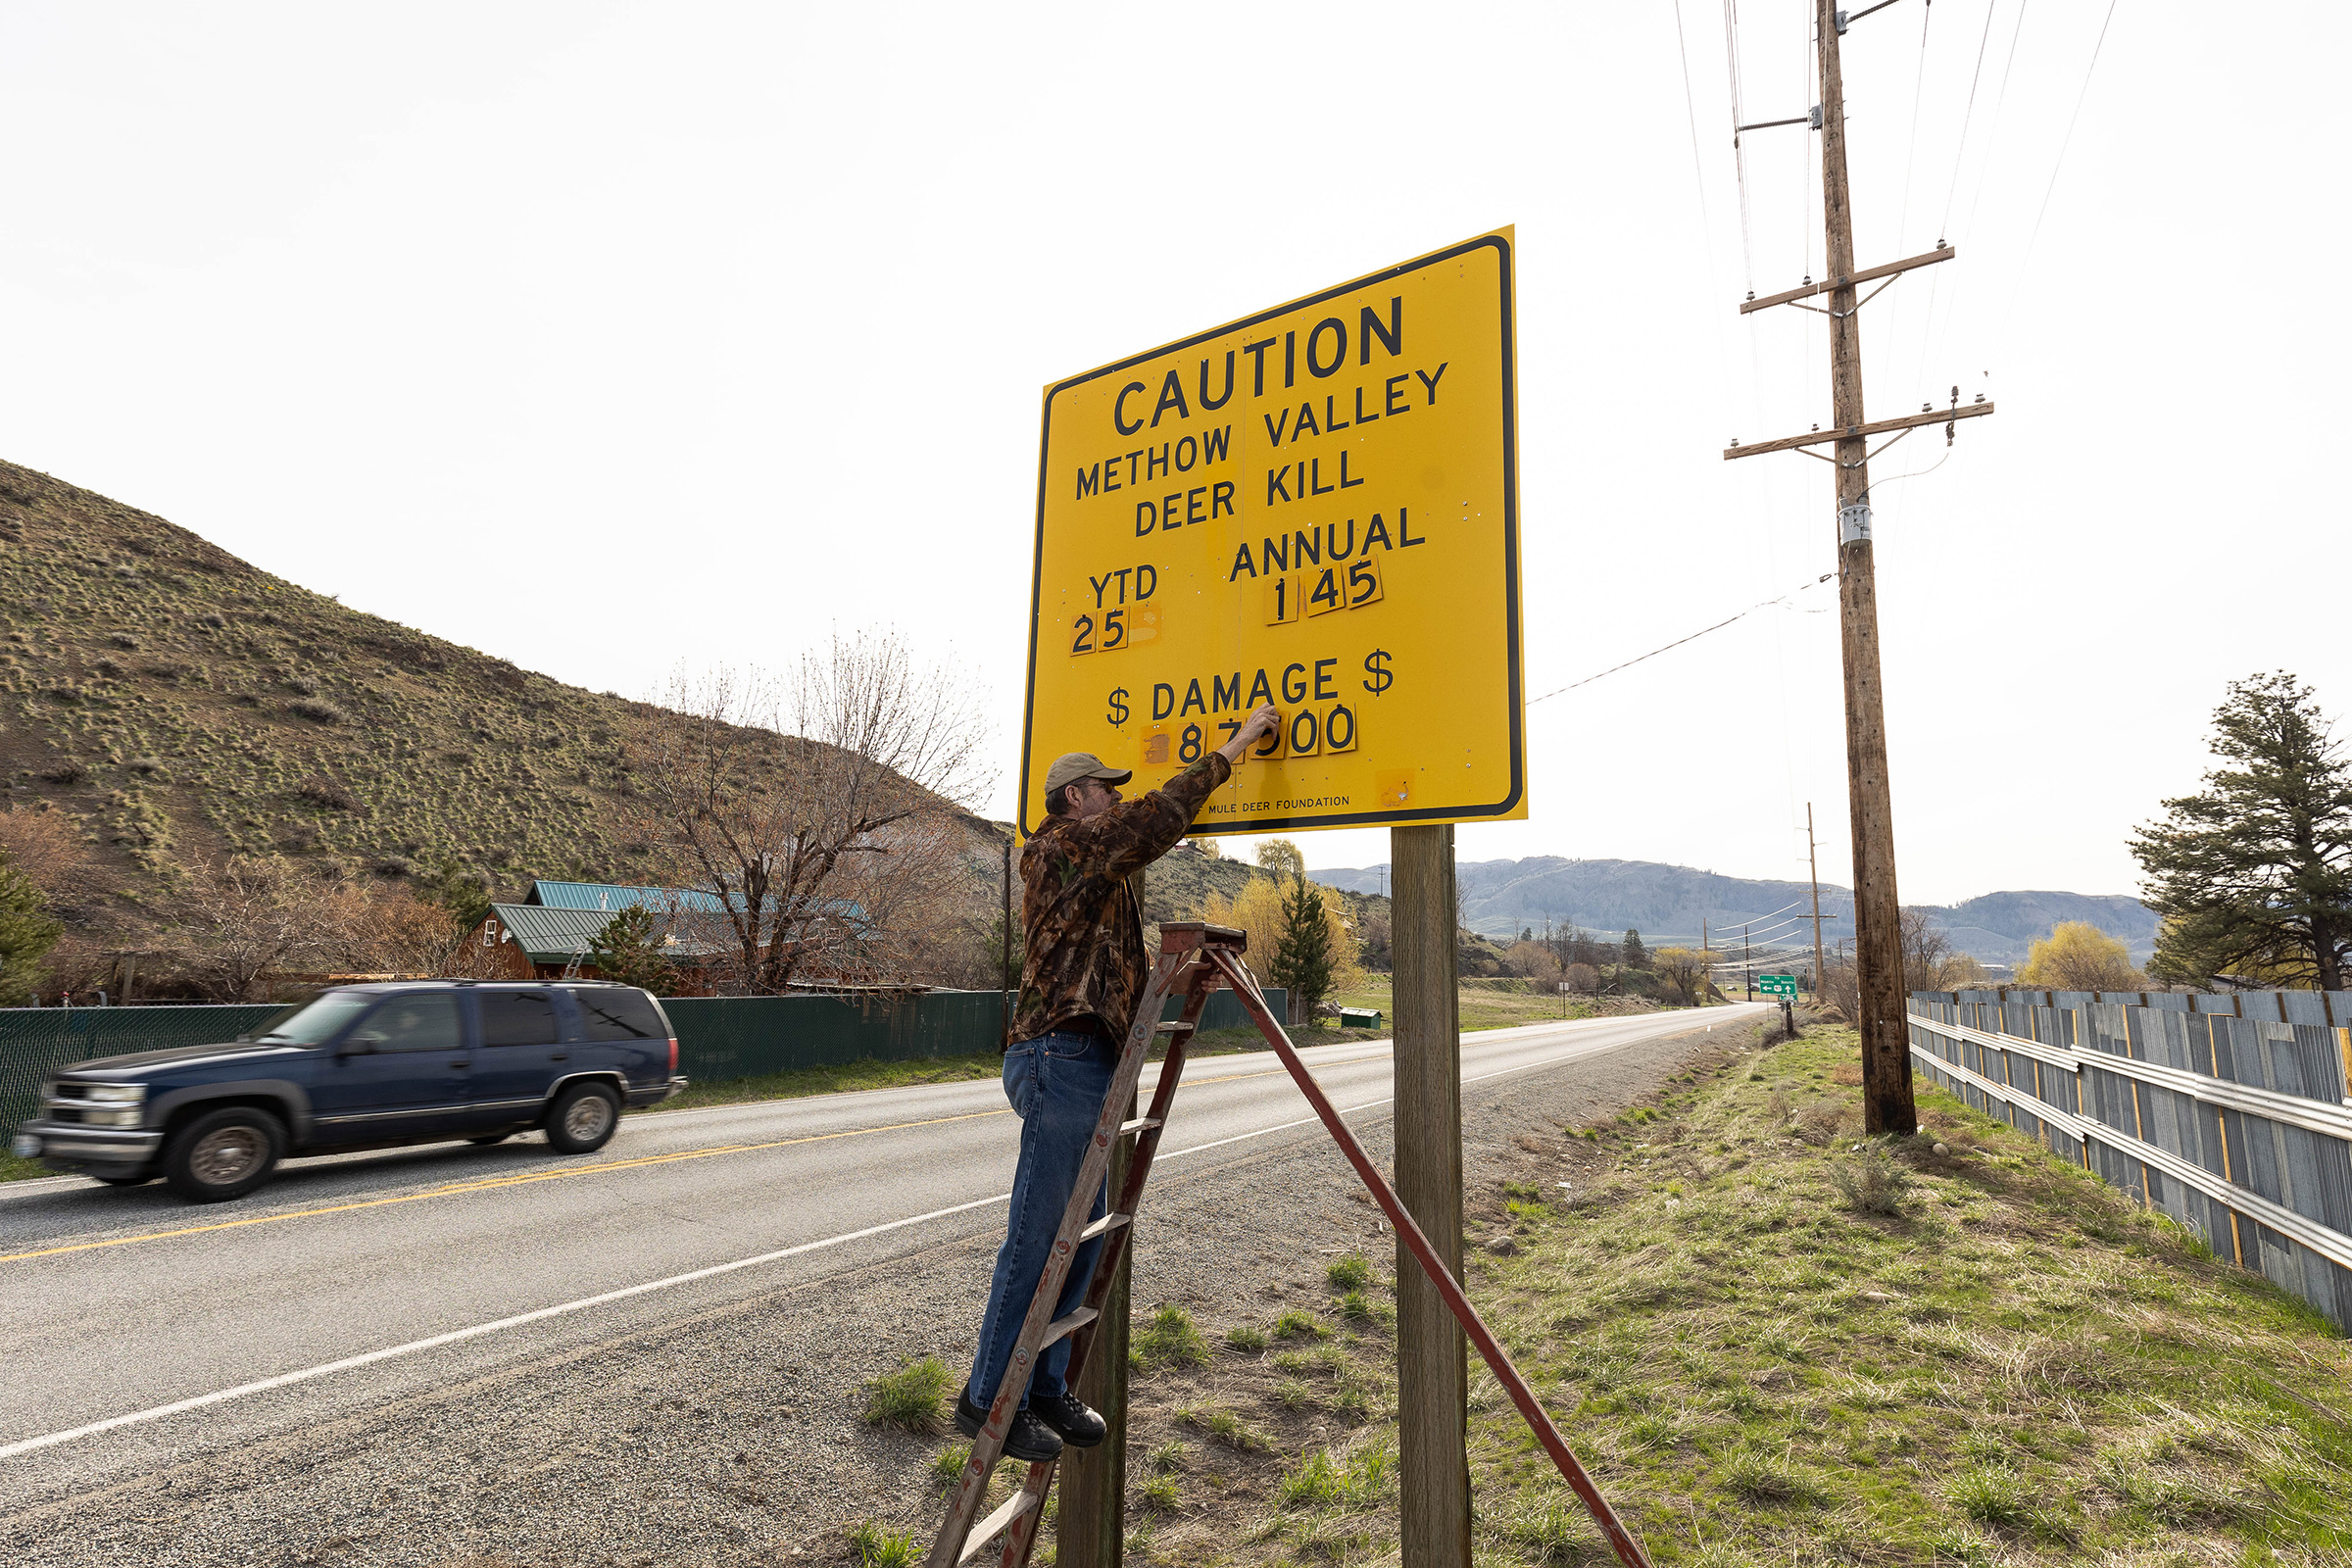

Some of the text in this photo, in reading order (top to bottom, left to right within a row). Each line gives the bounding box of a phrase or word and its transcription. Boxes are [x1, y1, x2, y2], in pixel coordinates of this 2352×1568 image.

[1114, 295, 1402, 436] CAUTION
[1076, 362, 1449, 501] METHOW VALLEY
[1136, 450, 1364, 538] DEER KILL
[1229, 507, 1426, 583] ANNUAL
[1089, 564, 1157, 610] YTD
[1275, 559, 1377, 621] 145
[1072, 610, 1124, 653] 25
[1106, 648, 1394, 729] $ DAMAGE $
[1208, 804, 1237, 814] MULE
[1242, 802, 1271, 812] DEER
[1276, 796, 1349, 810] FOUNDATION
